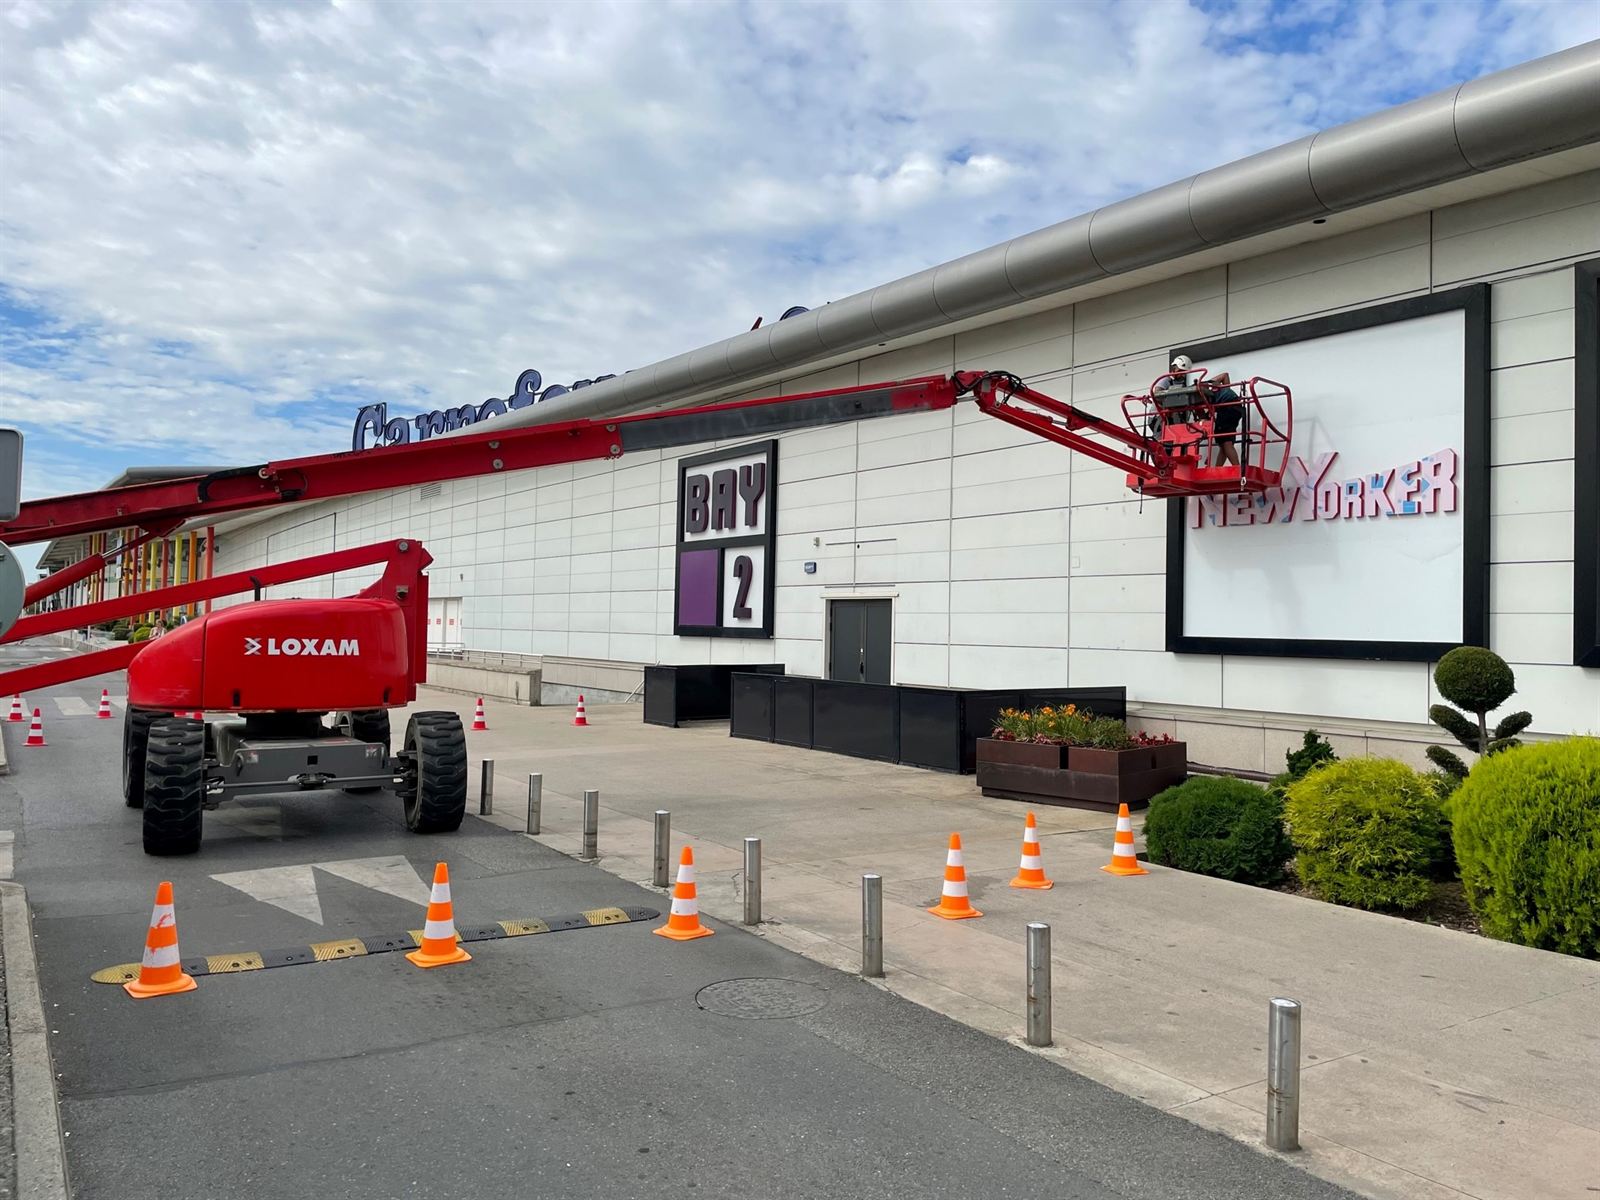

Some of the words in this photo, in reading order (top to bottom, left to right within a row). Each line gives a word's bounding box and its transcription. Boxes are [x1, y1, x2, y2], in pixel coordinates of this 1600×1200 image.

[352, 369, 636, 451] Carrf
[686, 462, 766, 534] BAY
[732, 555, 753, 620] 2
[267, 638, 360, 656] LOXAM
